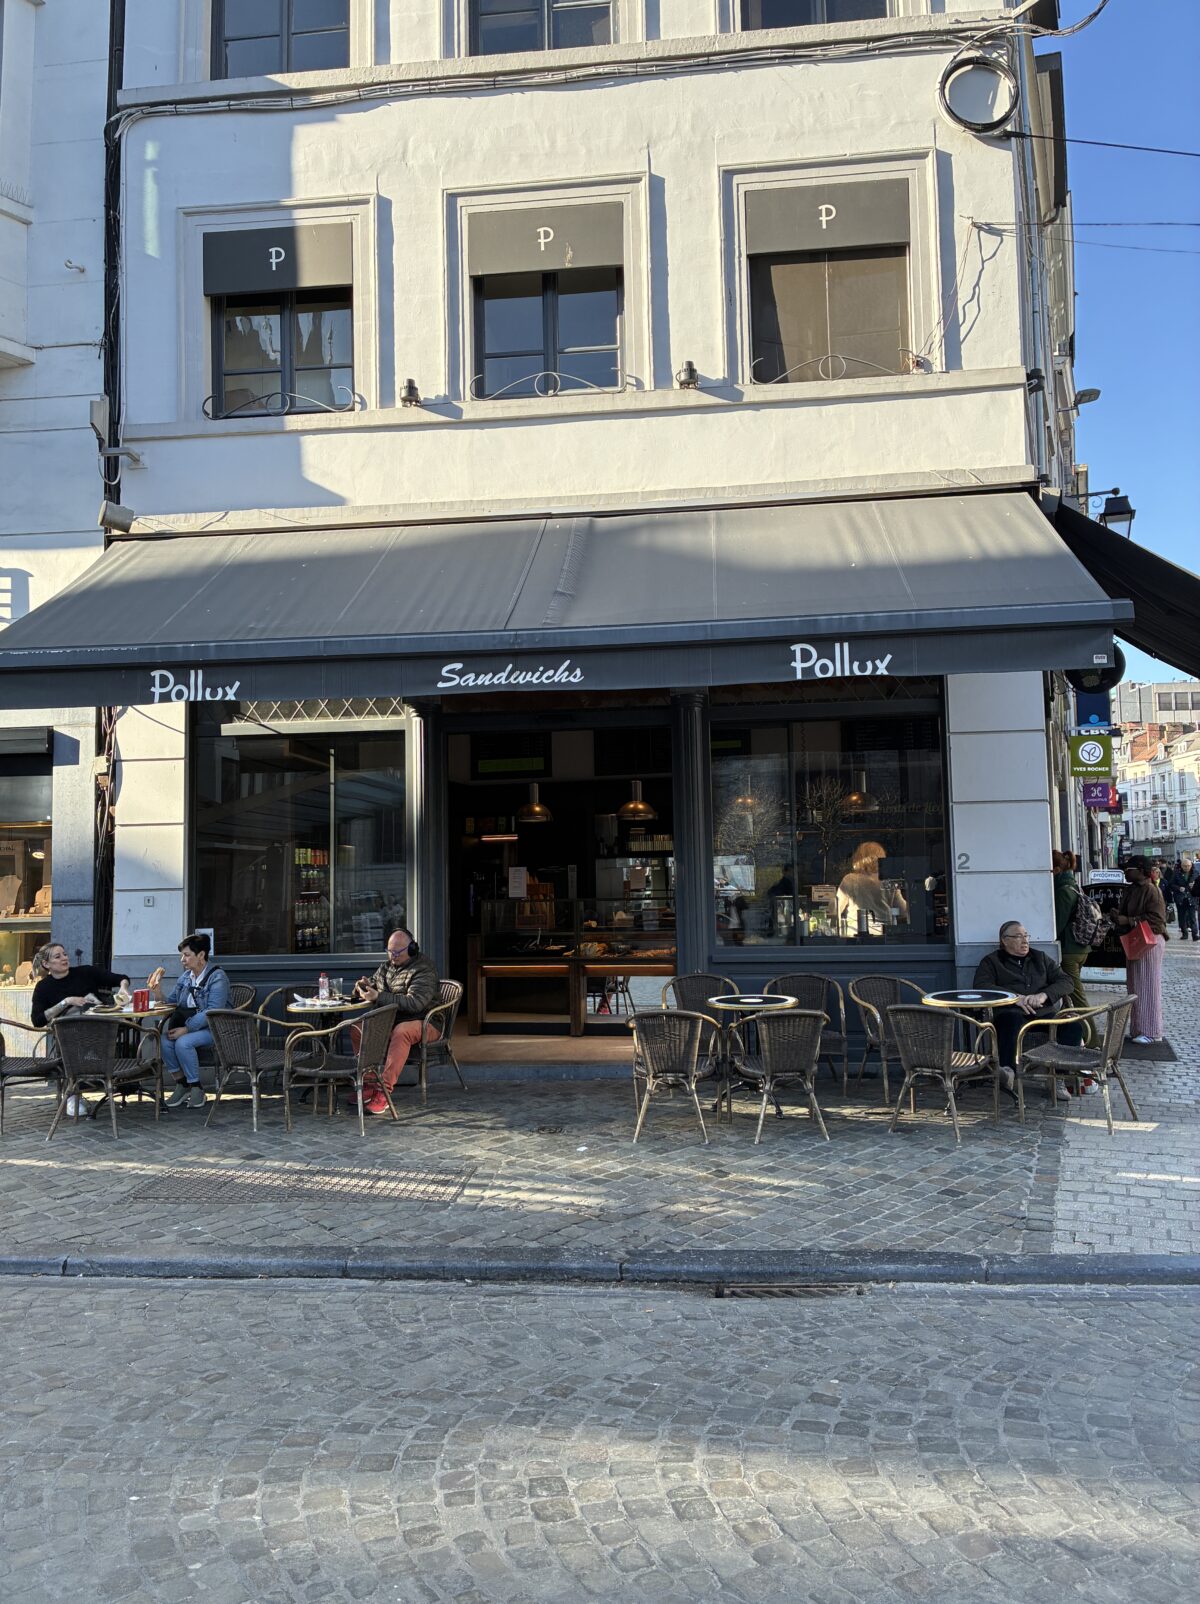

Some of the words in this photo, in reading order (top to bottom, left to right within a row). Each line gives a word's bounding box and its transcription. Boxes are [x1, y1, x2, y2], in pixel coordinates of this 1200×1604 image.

[818, 204, 836, 229] P
[537, 226, 554, 251] P
[269, 246, 285, 270] P
[437, 659, 584, 688] Sandwichs
[790, 642, 893, 680] Pollux
[150, 669, 240, 703] Pollux
[957, 852, 970, 870] 2
